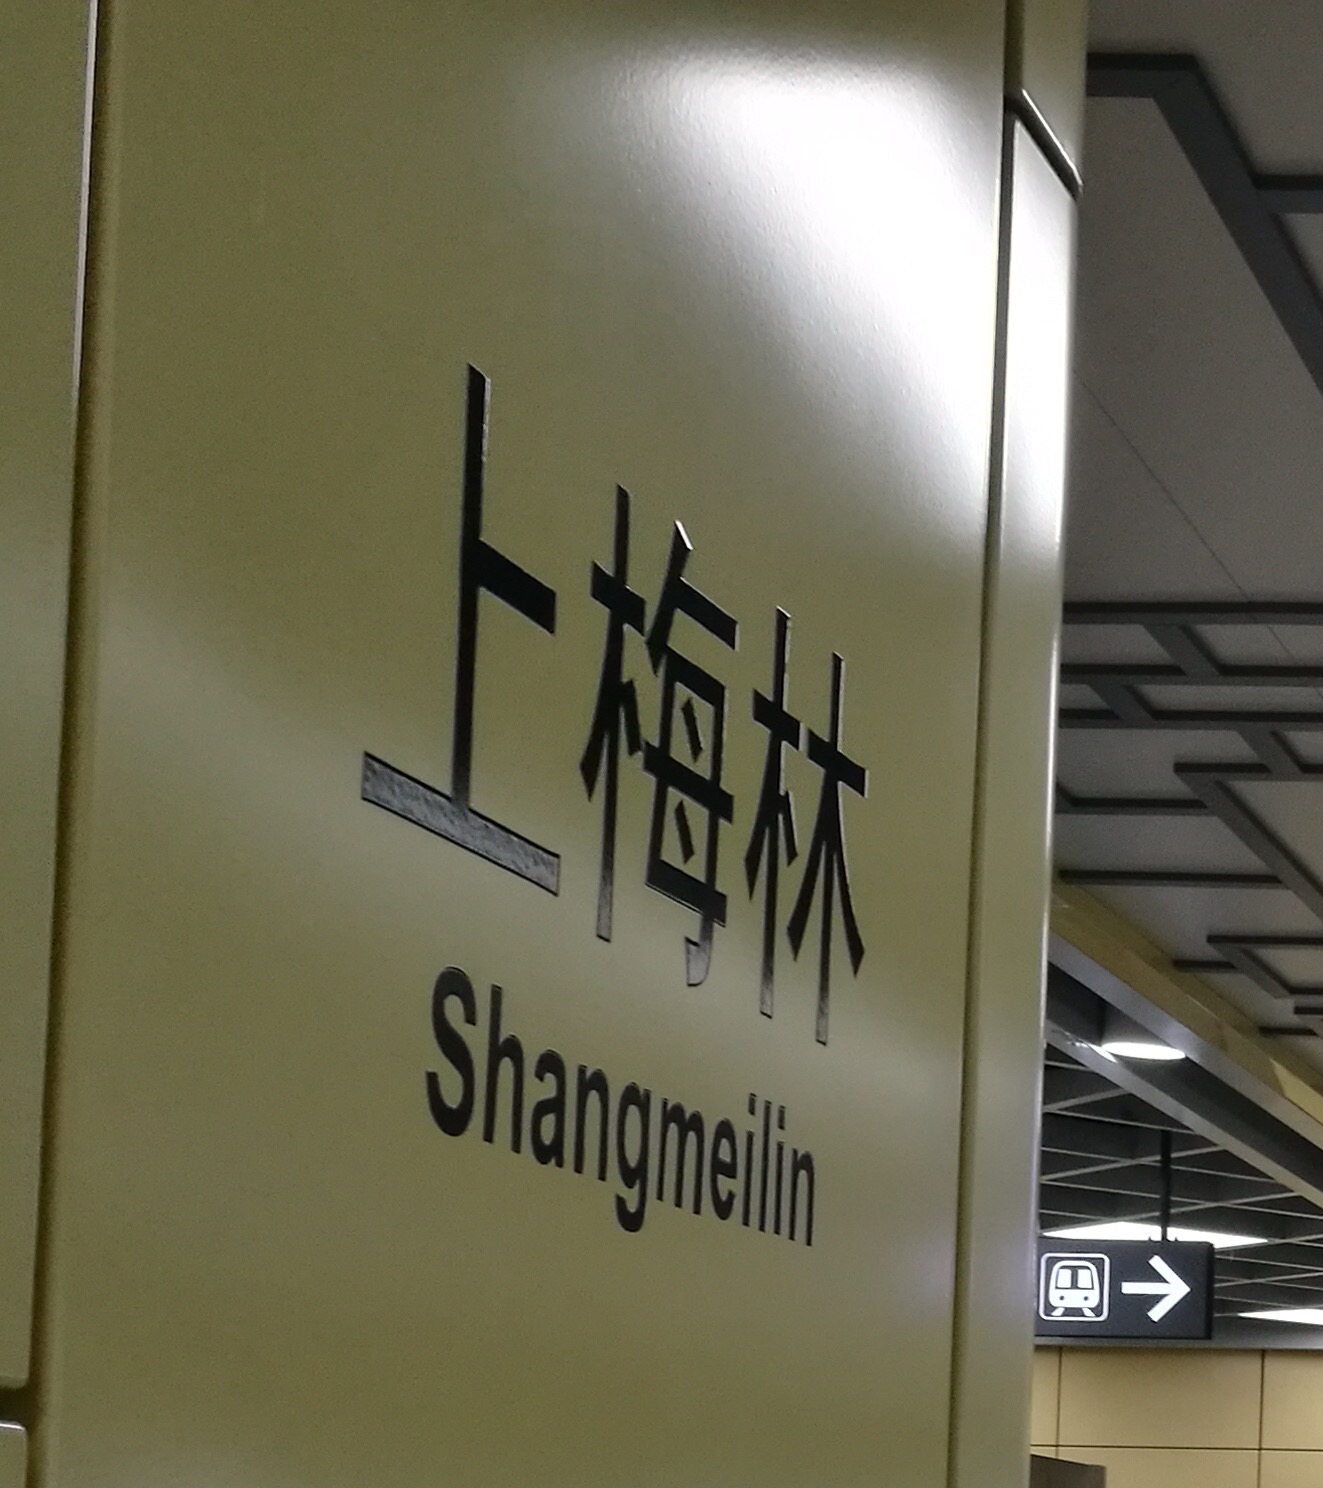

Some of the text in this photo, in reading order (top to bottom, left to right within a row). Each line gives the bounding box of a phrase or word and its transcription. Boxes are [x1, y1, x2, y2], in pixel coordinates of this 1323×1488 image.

[361, 363, 868, 1046] 上梅林
[425, 966, 817, 1247] Shangmeilin
